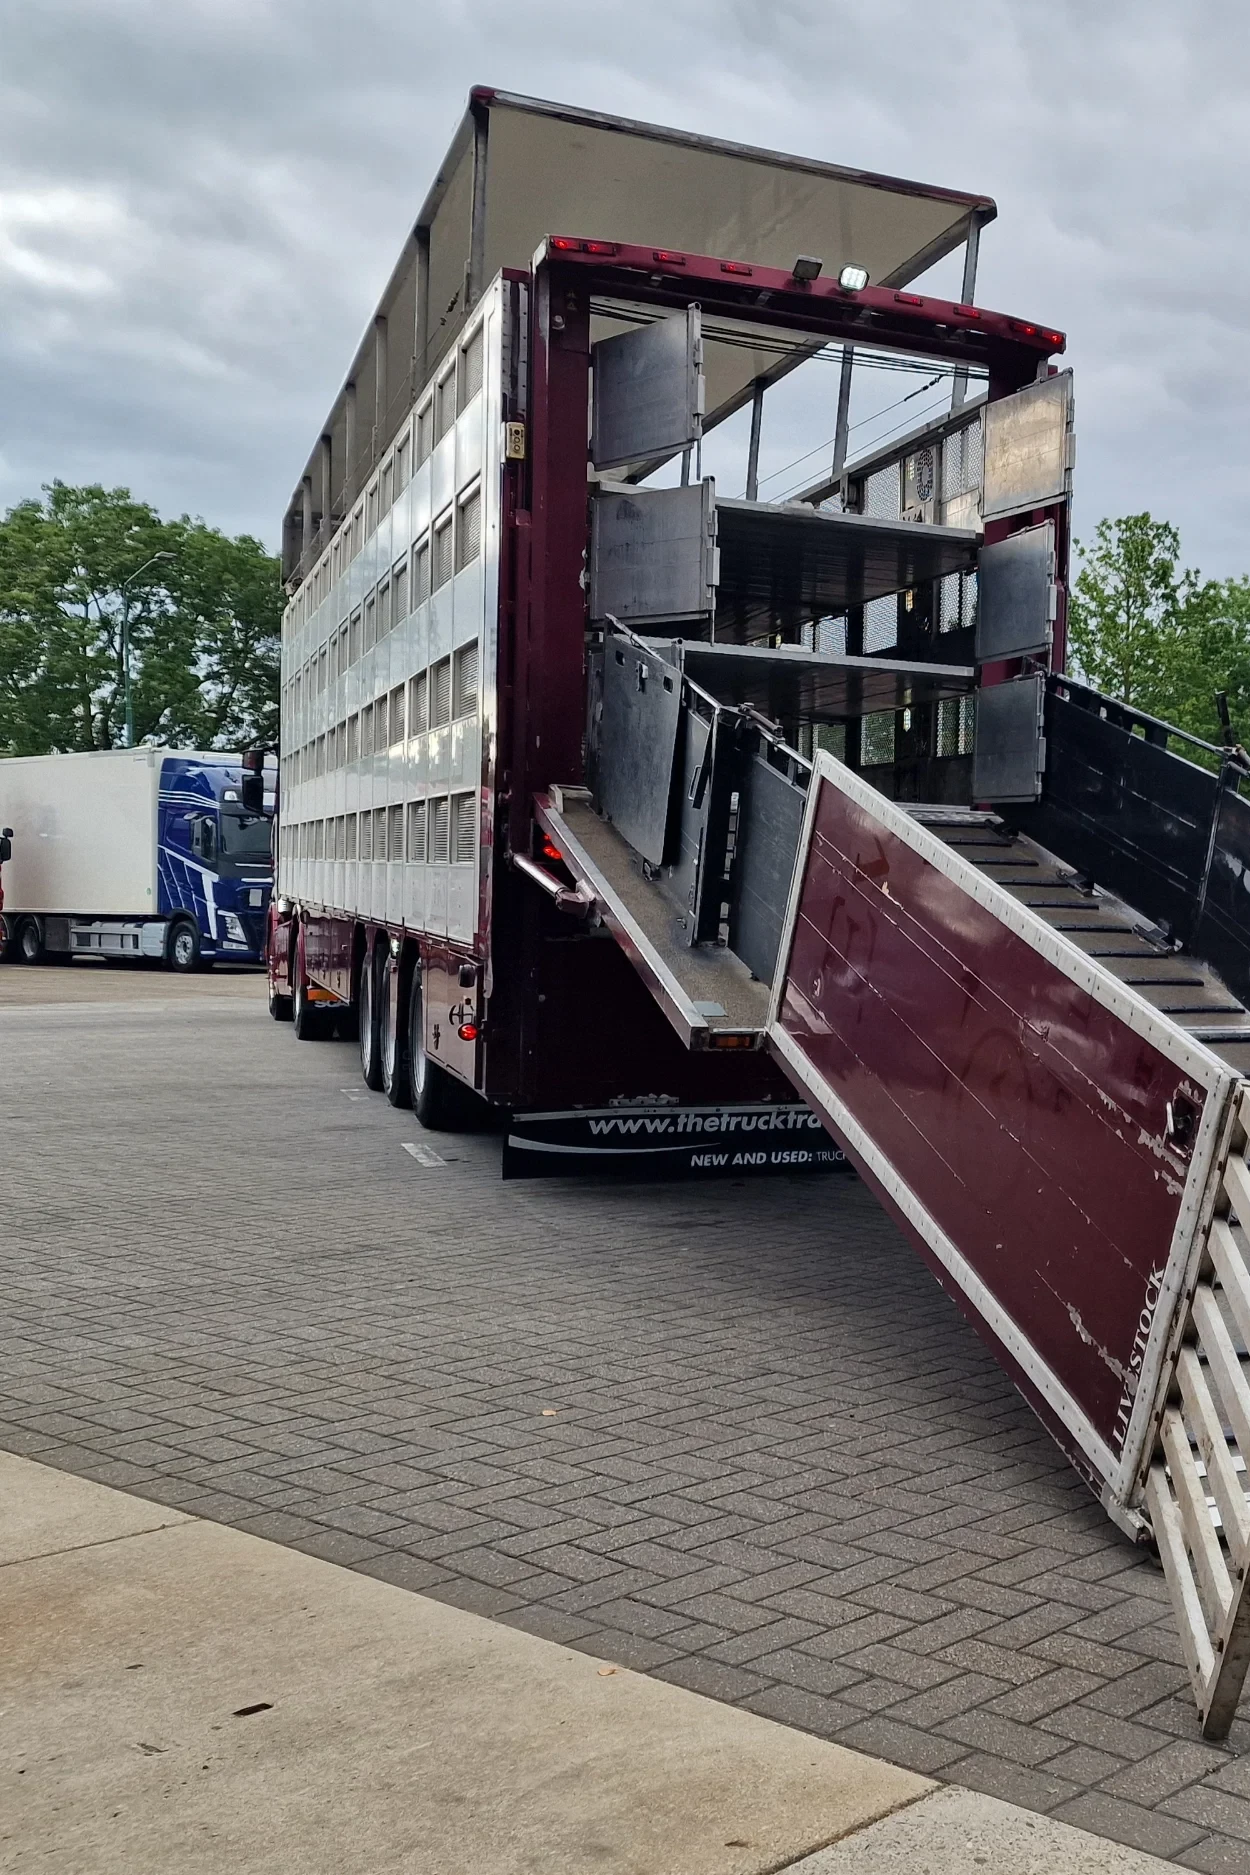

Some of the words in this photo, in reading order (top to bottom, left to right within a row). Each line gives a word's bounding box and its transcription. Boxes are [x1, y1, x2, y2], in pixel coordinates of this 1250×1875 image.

[589, 1112, 822, 1135] www.thetrucktra
[690, 1153, 729, 1167] NEW
[732, 1152, 767, 1165] AND
[771, 1150, 813, 1164] USED:
[1113, 1268, 1165, 1447] LIVSTOCK
